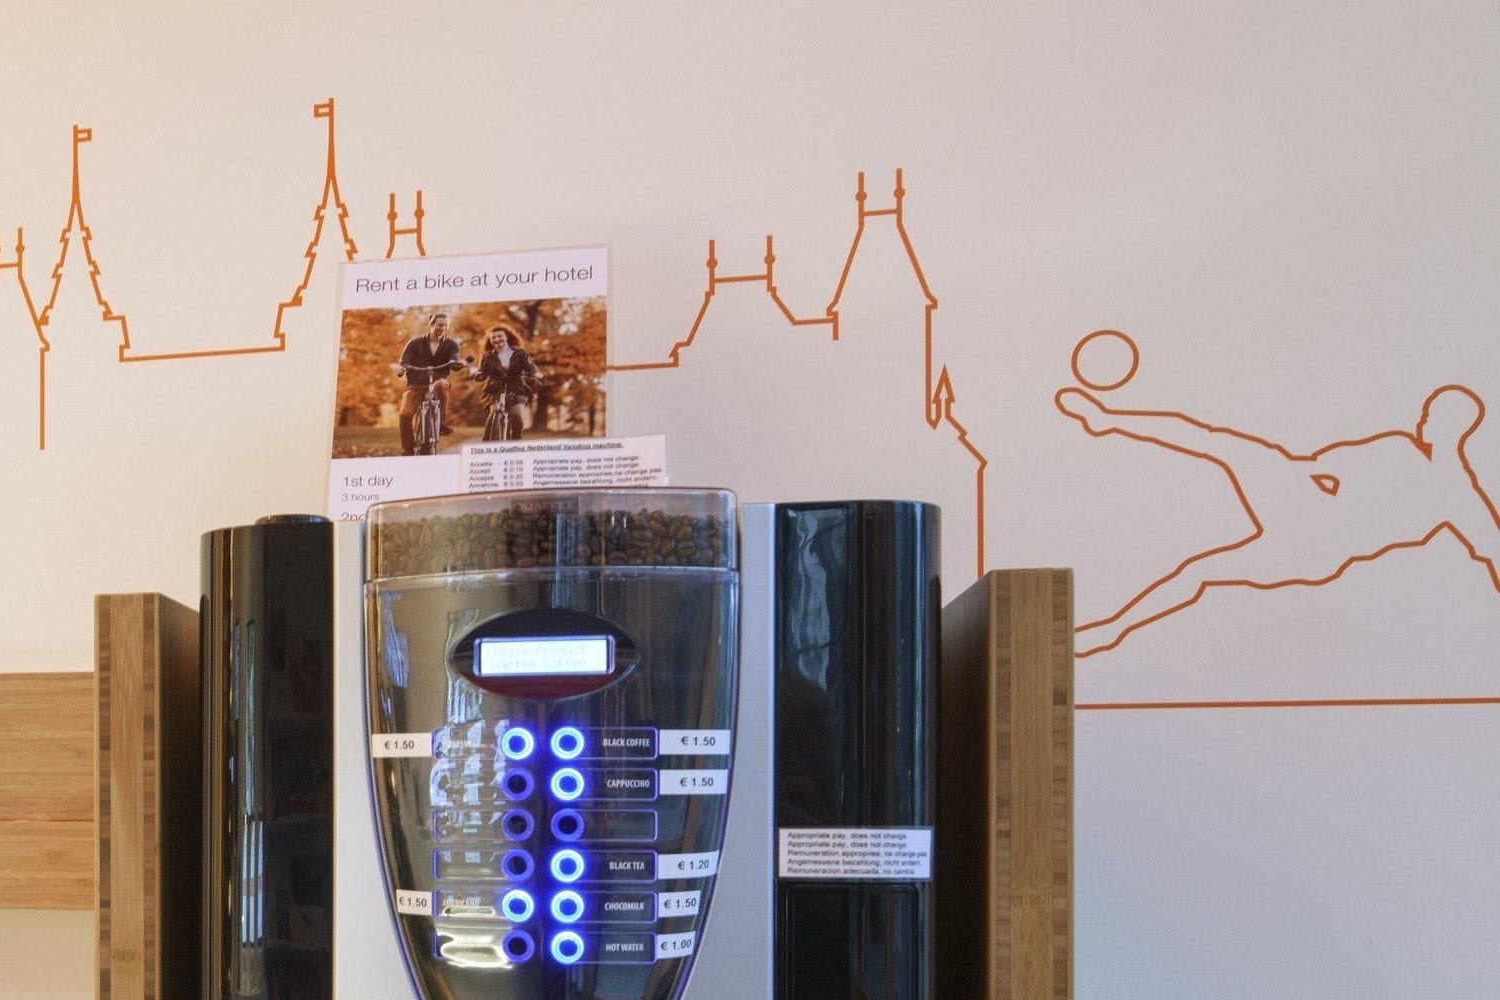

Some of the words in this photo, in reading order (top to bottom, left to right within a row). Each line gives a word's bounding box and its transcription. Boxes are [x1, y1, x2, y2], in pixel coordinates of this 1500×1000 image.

[356, 276, 399, 293] Rent
[406, 280, 418, 291] a
[424, 274, 464, 289] bike
[470, 273, 488, 287] at
[495, 271, 539, 288] your
[545, 265, 593, 282] hotel
[564, 443, 591, 451] Vending
[343, 475, 363, 487] 1st
[368, 475, 394, 488] day
[341, 493, 349, 502] 3
[351, 492, 380, 501] hours
[384, 741, 391, 750] €
[394, 740, 415, 750] 1.50
[603, 738, 625, 747] BLACK
[626, 738, 650, 747] COFFEE
[681, 736, 689, 745] €
[693, 736, 716, 746] 1.50
[606, 779, 650, 788] CAPPUCCINO
[680, 777, 687, 787] €
[691, 777, 714, 787] 1.50
[788, 831, 830, 840] Appropriate
[788, 840, 830, 849] Appropriate
[609, 861, 632, 870] BLACK
[633, 861, 645, 870] TEA
[678, 860, 685, 870] €
[689, 860, 710, 870] 1.20
[399, 896, 405, 906] €
[407, 897, 427, 907] 1.50
[604, 901, 645, 911] CHOCOMILK
[664, 899, 671, 909] €
[676, 897, 697, 908] 1.50
[605, 943, 620, 952] HOT
[621, 943, 644, 952] WATER
[661, 941, 668, 951] €
[672, 939, 692, 950] 1.00
